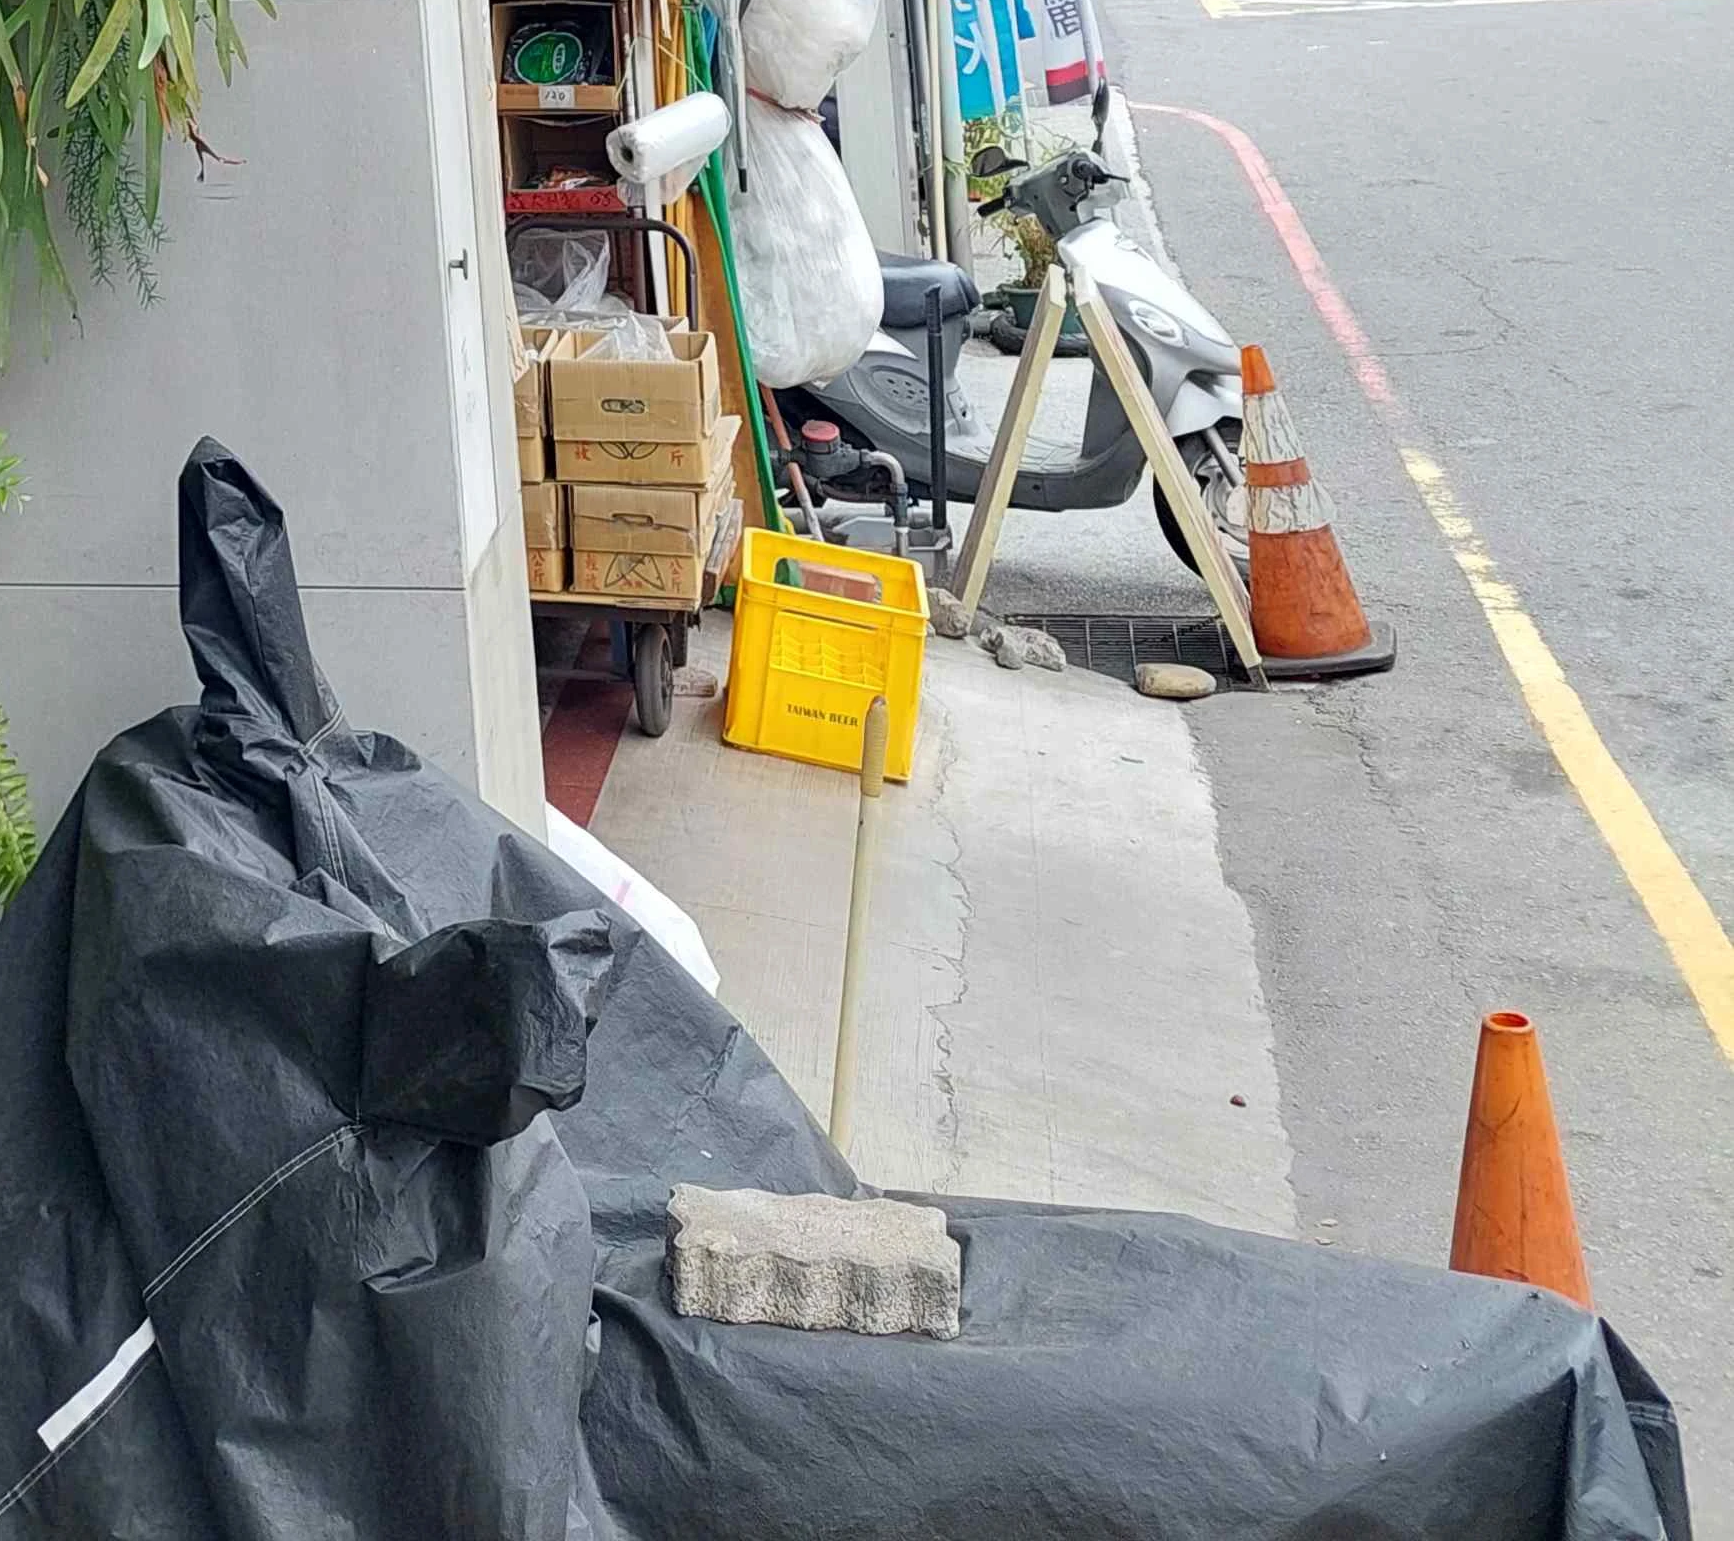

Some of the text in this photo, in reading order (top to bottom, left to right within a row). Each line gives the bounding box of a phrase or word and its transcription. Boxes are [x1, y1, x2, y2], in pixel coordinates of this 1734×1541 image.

[545, 88, 566, 102] 120
[787, 703, 858, 726] TAIWAN BEER
